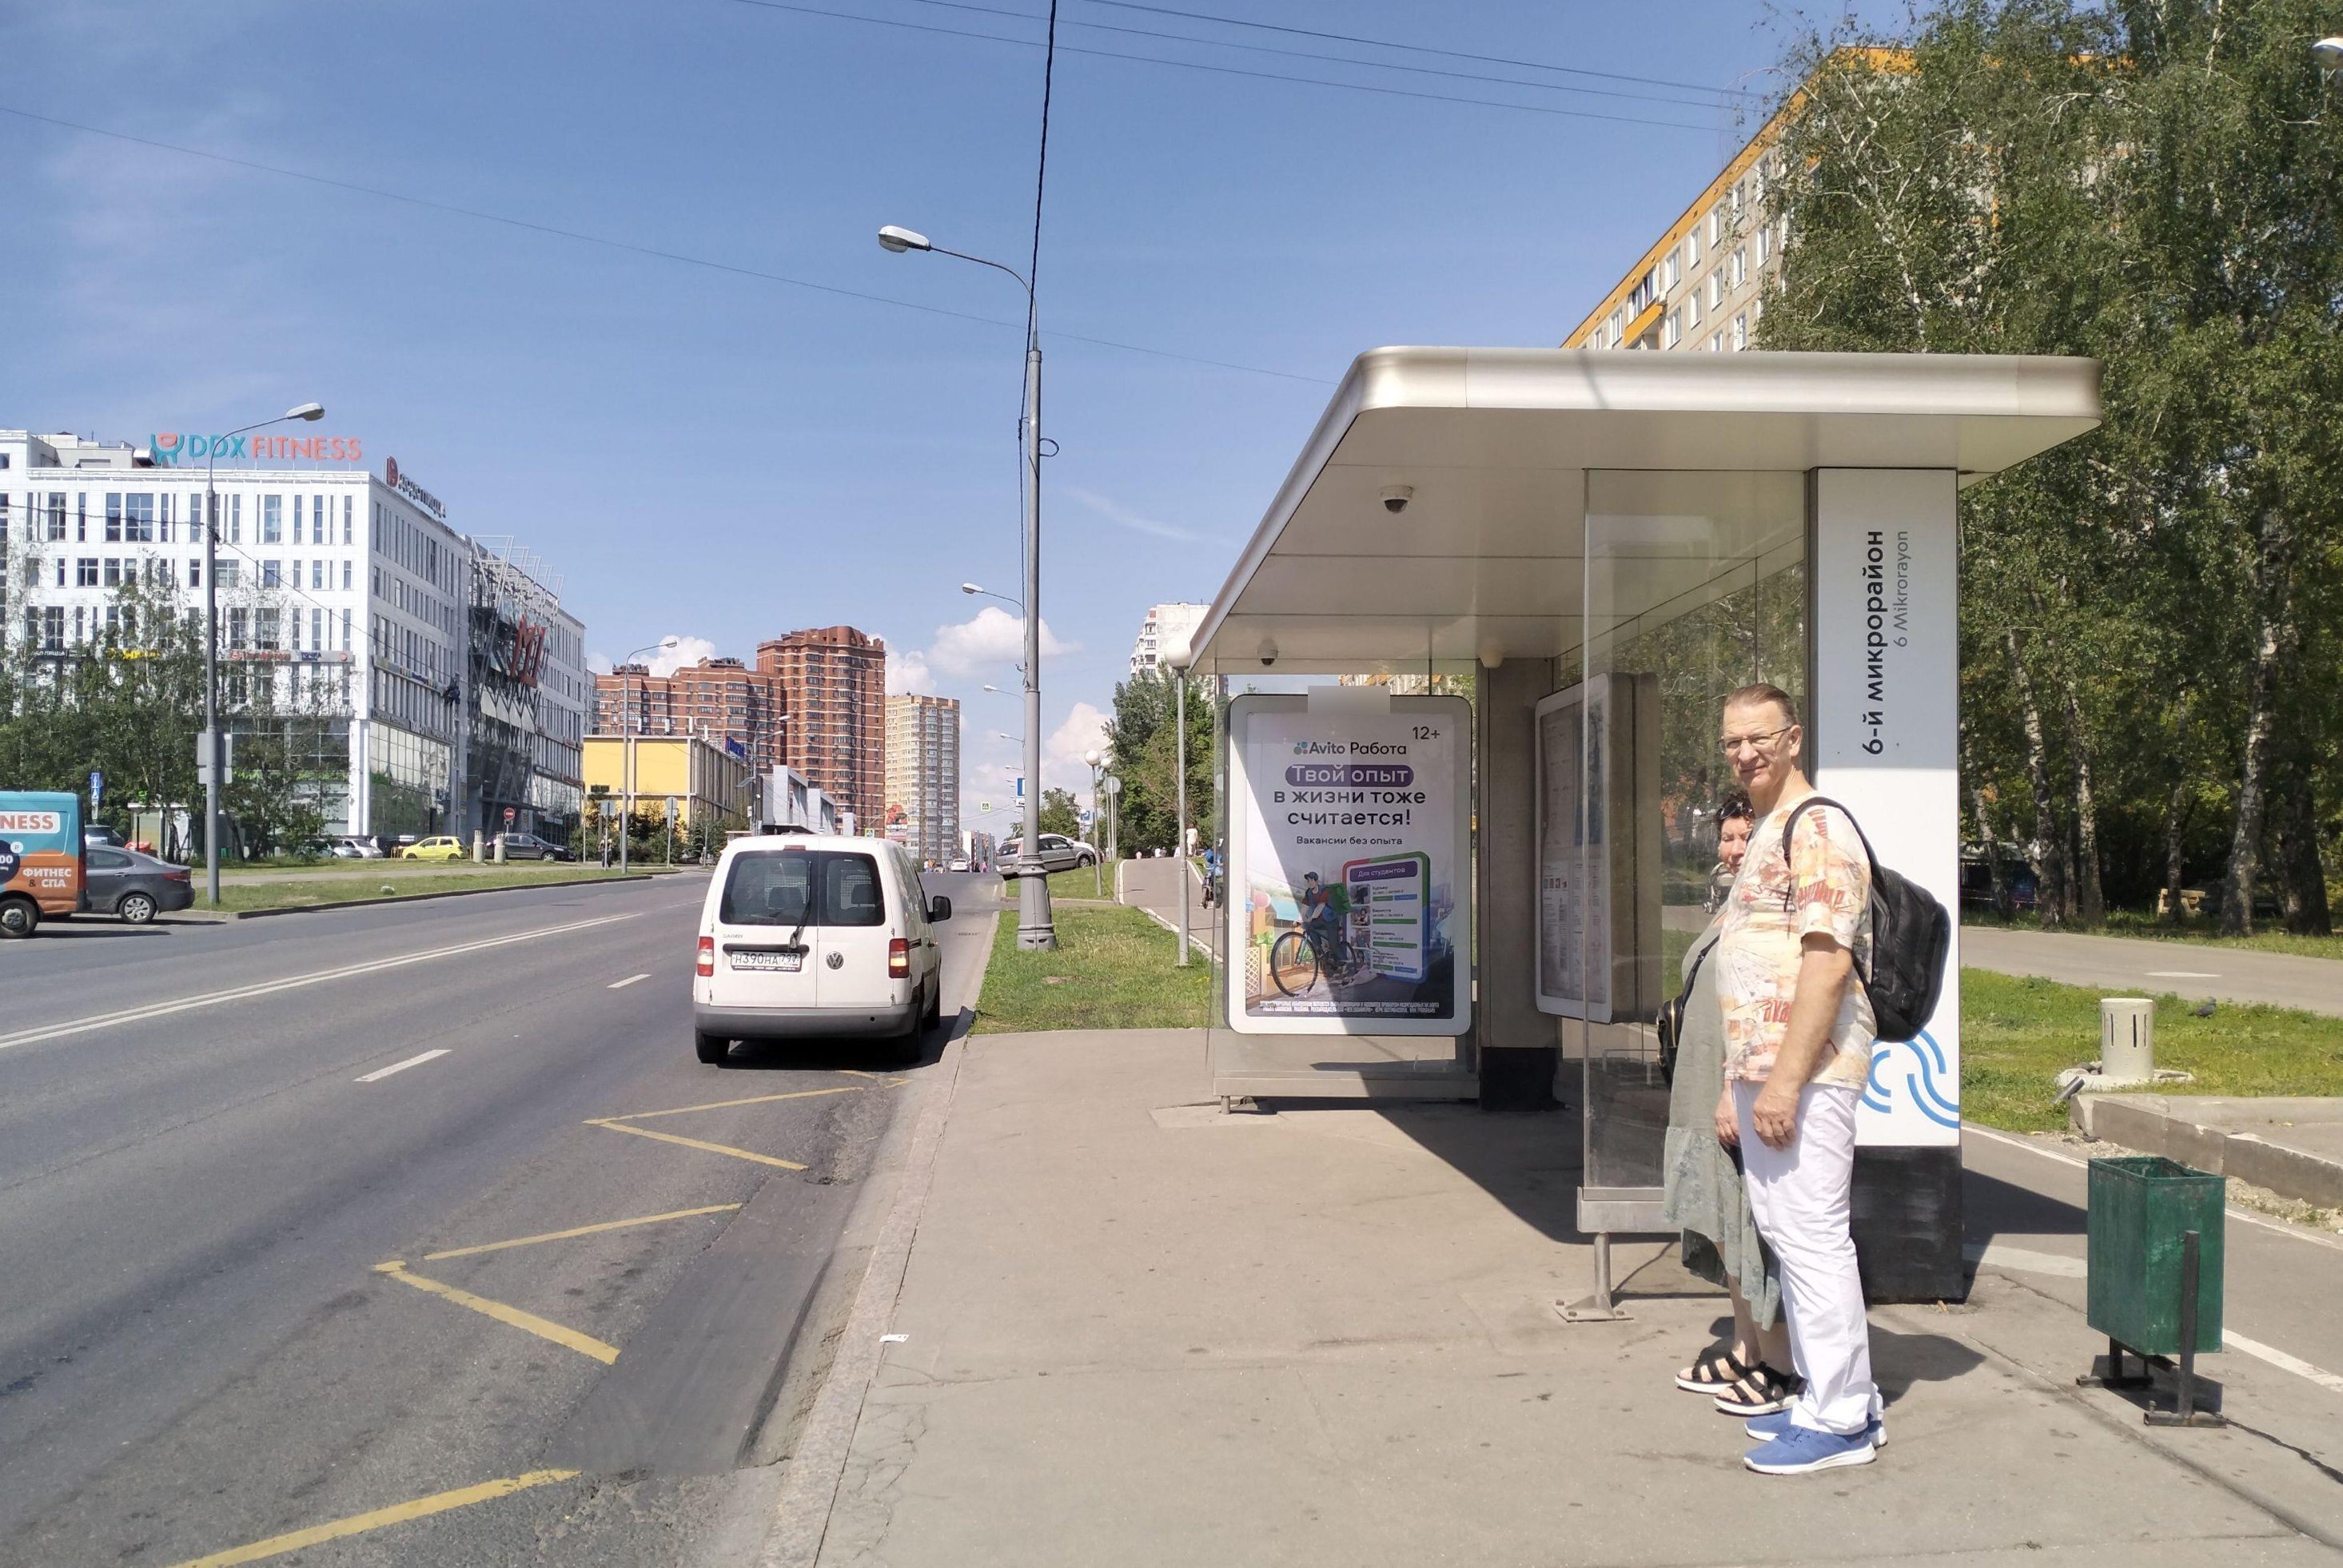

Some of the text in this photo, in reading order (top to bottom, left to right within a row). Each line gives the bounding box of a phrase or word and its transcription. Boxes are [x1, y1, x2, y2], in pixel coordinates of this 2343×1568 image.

[187, 434, 362, 461] DDX FITNESS
[1893, 531, 1912, 647] 6 Mikrorayon
[1862, 531, 1888, 755] 6-й микрорайон
[1413, 726, 1441, 740] 12+
[1309, 742, 1407, 754] Avito Работа
[1292, 764, 1409, 782] Твой опыт
[1274, 790, 1426, 804] в жизни тоже
[1287, 809, 1411, 826] считается!
[1297, 836, 1346, 845] Вакансии
[1349, 836, 1368, 845] без
[22, 868, 73, 878] ФИТНЕС
[1371, 868, 1406, 877] студентов
[42, 879, 66, 888] СПА
